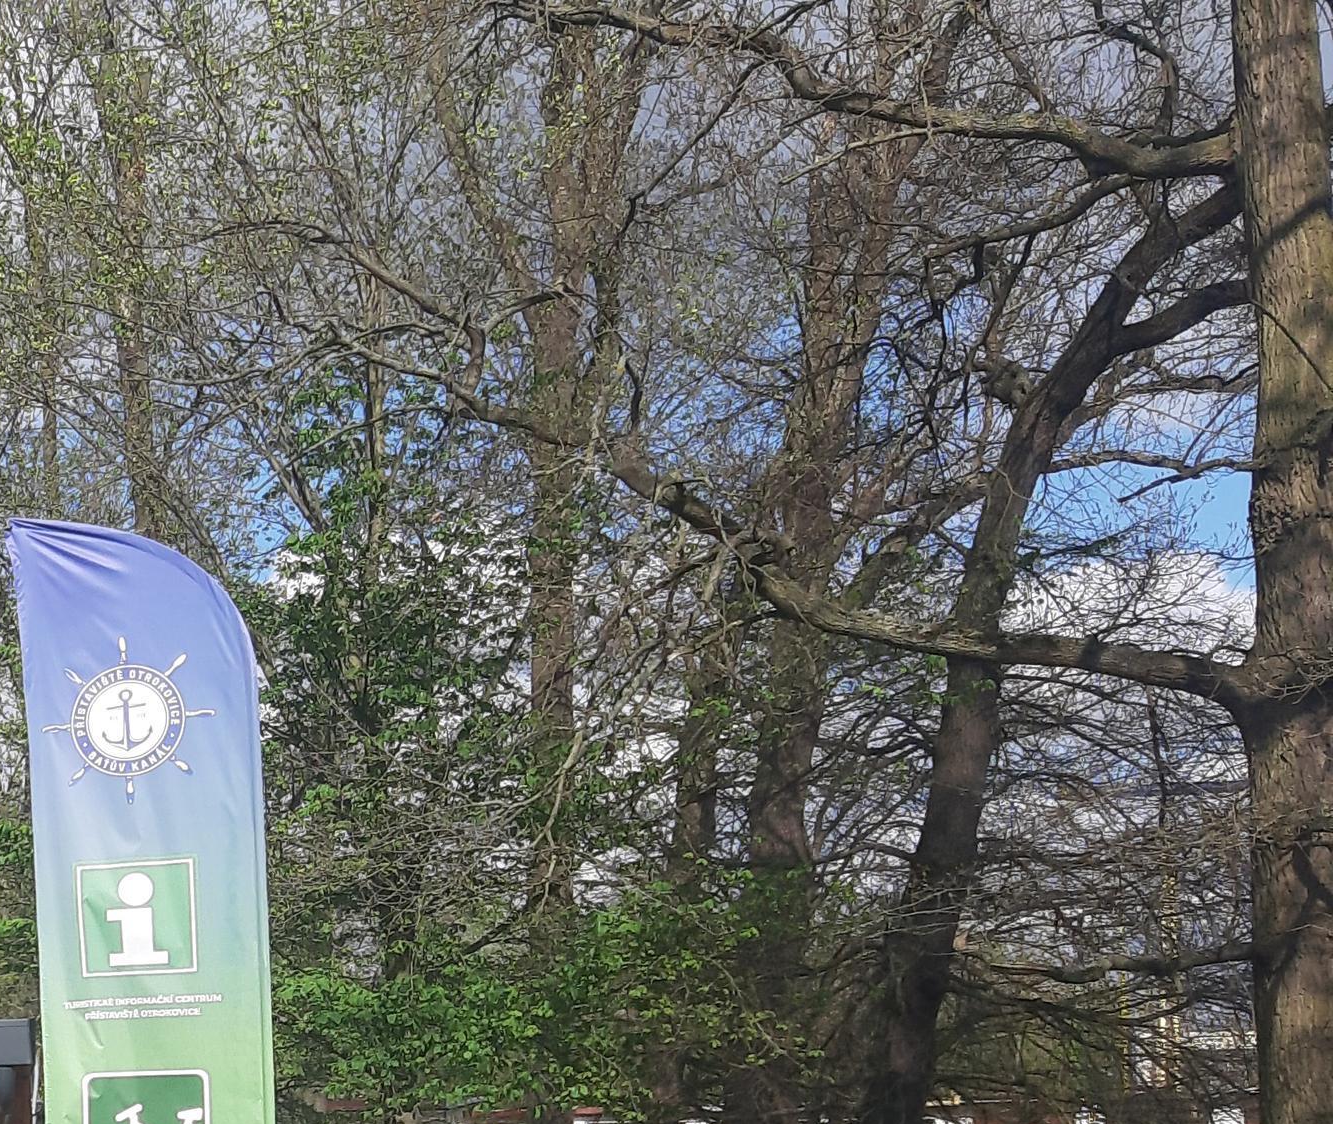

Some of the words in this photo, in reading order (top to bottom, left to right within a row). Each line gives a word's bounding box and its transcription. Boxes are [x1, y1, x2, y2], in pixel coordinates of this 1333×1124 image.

[129, 669, 180, 725] OTROKOVICE
[88, 751, 126, 773] BAŤŮV
[132, 744, 171, 771] KANÁL
[175, 993, 222, 1004] CENTRUM
